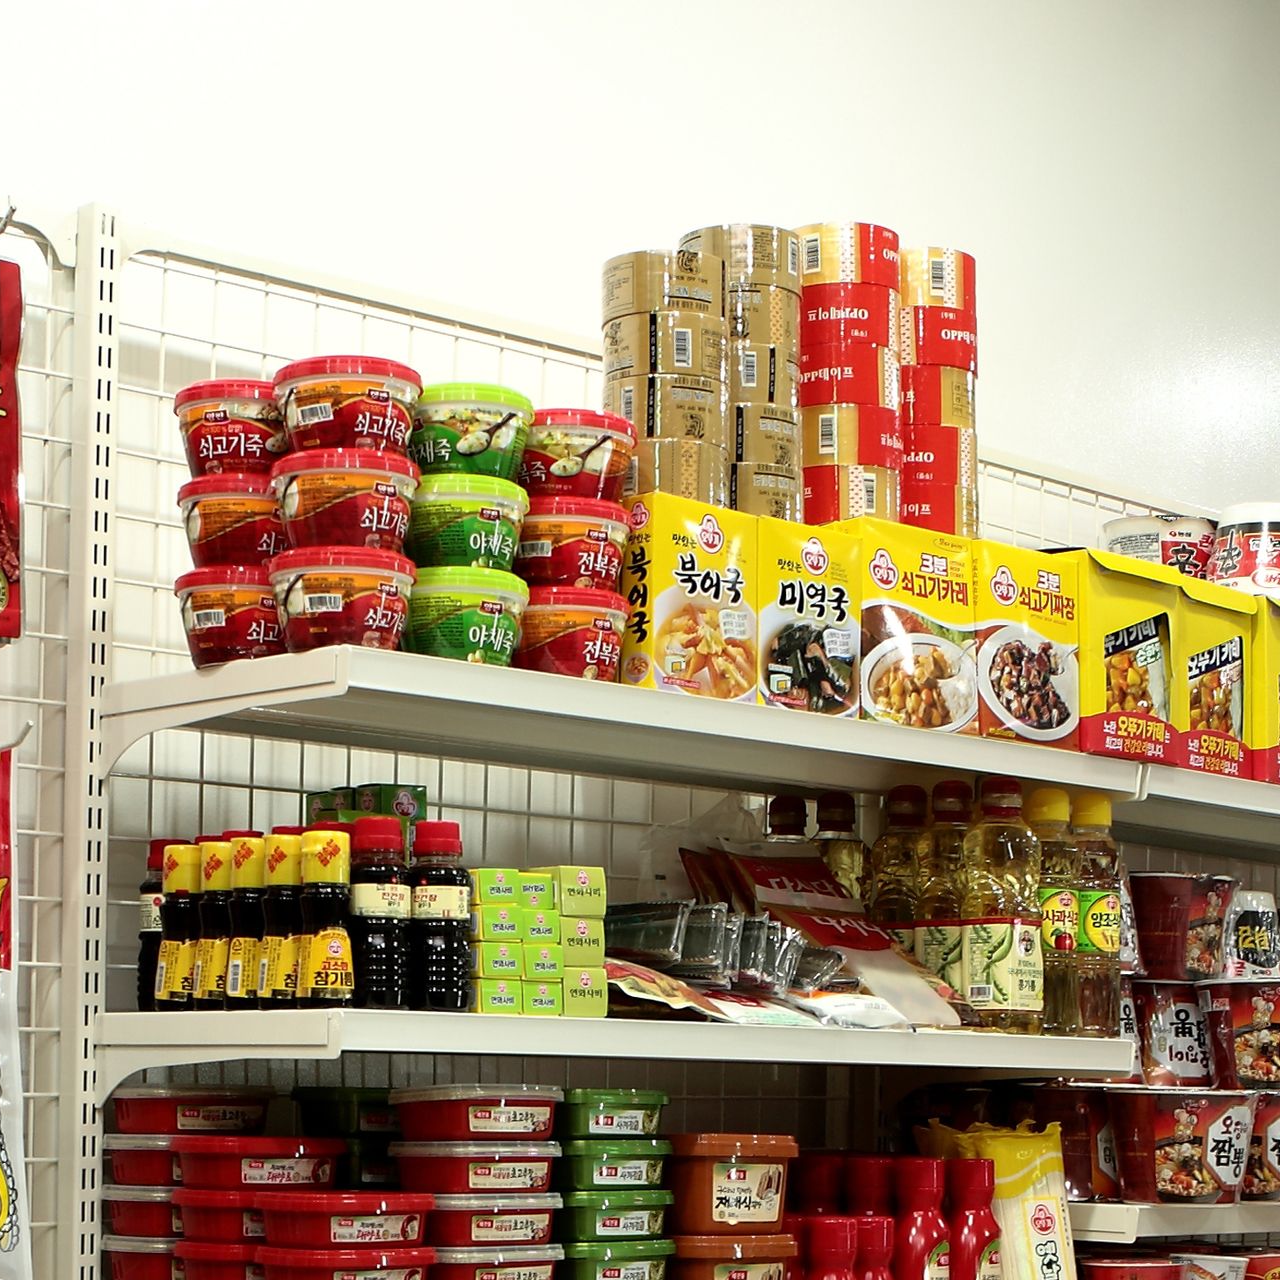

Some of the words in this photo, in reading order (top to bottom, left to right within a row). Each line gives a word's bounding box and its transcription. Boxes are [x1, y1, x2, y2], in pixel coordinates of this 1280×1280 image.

[198, 434, 265, 460] 쇠고기죽
[672, 532, 698, 550] 맛있는
[777, 556, 803, 574] 맛있는
[919, 552, 949, 578] 3분
[673, 554, 745, 604] 북어국
[900, 575, 969, 607] 쇠고기카레
[1036, 570, 1063, 594] 3분
[625, 545, 652, 643] 북어국
[777, 579, 849, 623] 미역국
[1017, 584, 1076, 622] 쇠고기짜장
[468, 624, 519, 652] 야채죽
[1216, 637, 1242, 663] 카레
[1103, 719, 1118, 735] 노란
[1117, 715, 1143, 738] 오뚜기
[313, 968, 356, 987] 참기름
[320, 960, 349, 972] 고소한
